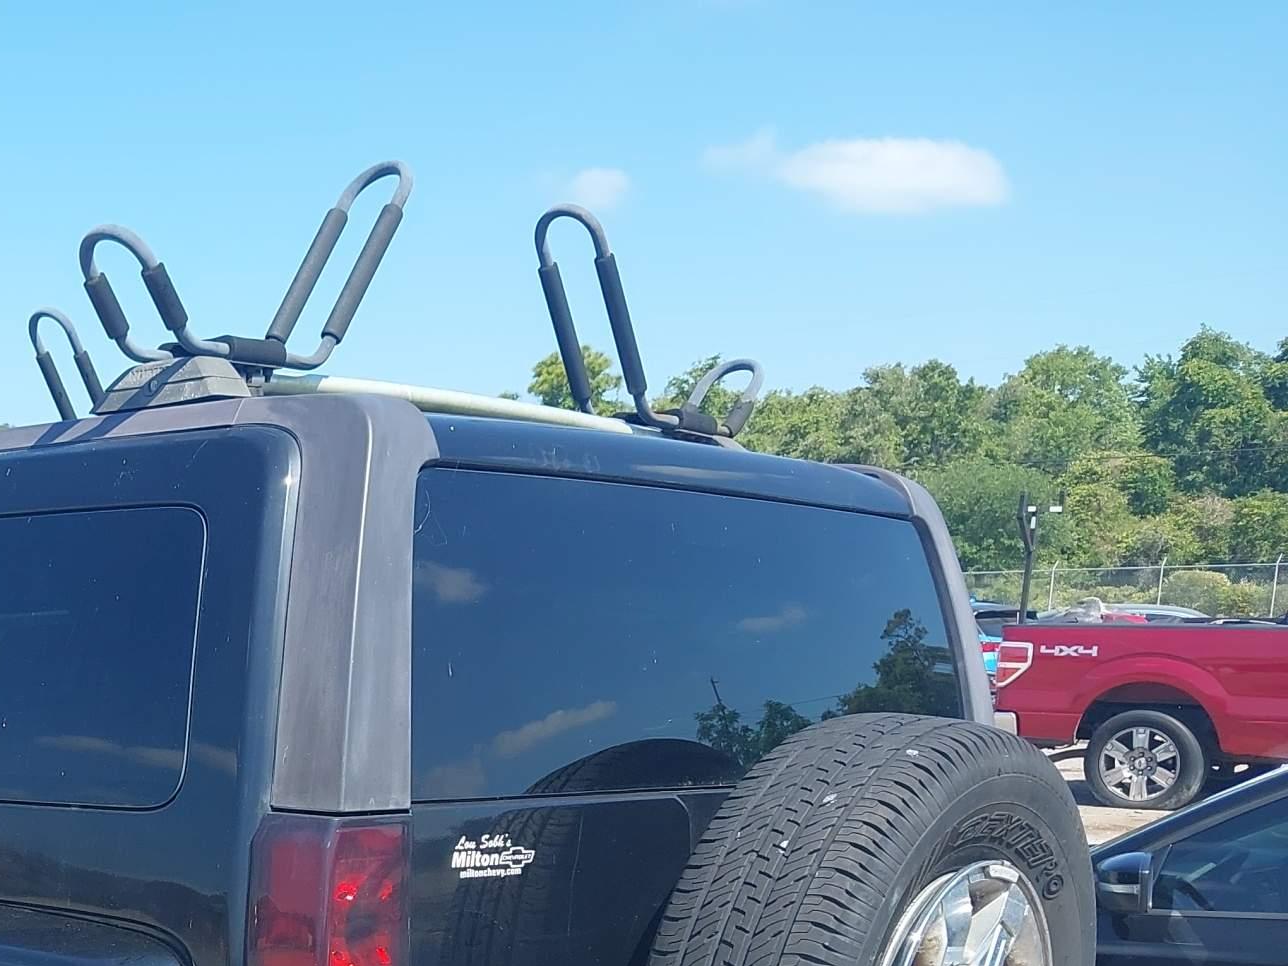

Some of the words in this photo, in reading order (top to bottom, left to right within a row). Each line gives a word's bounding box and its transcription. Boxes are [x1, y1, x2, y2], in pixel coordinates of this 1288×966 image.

[455, 836, 476, 849] Lou
[451, 851, 499, 868] Milton
[459, 867, 522, 878] miltonchevy.com
